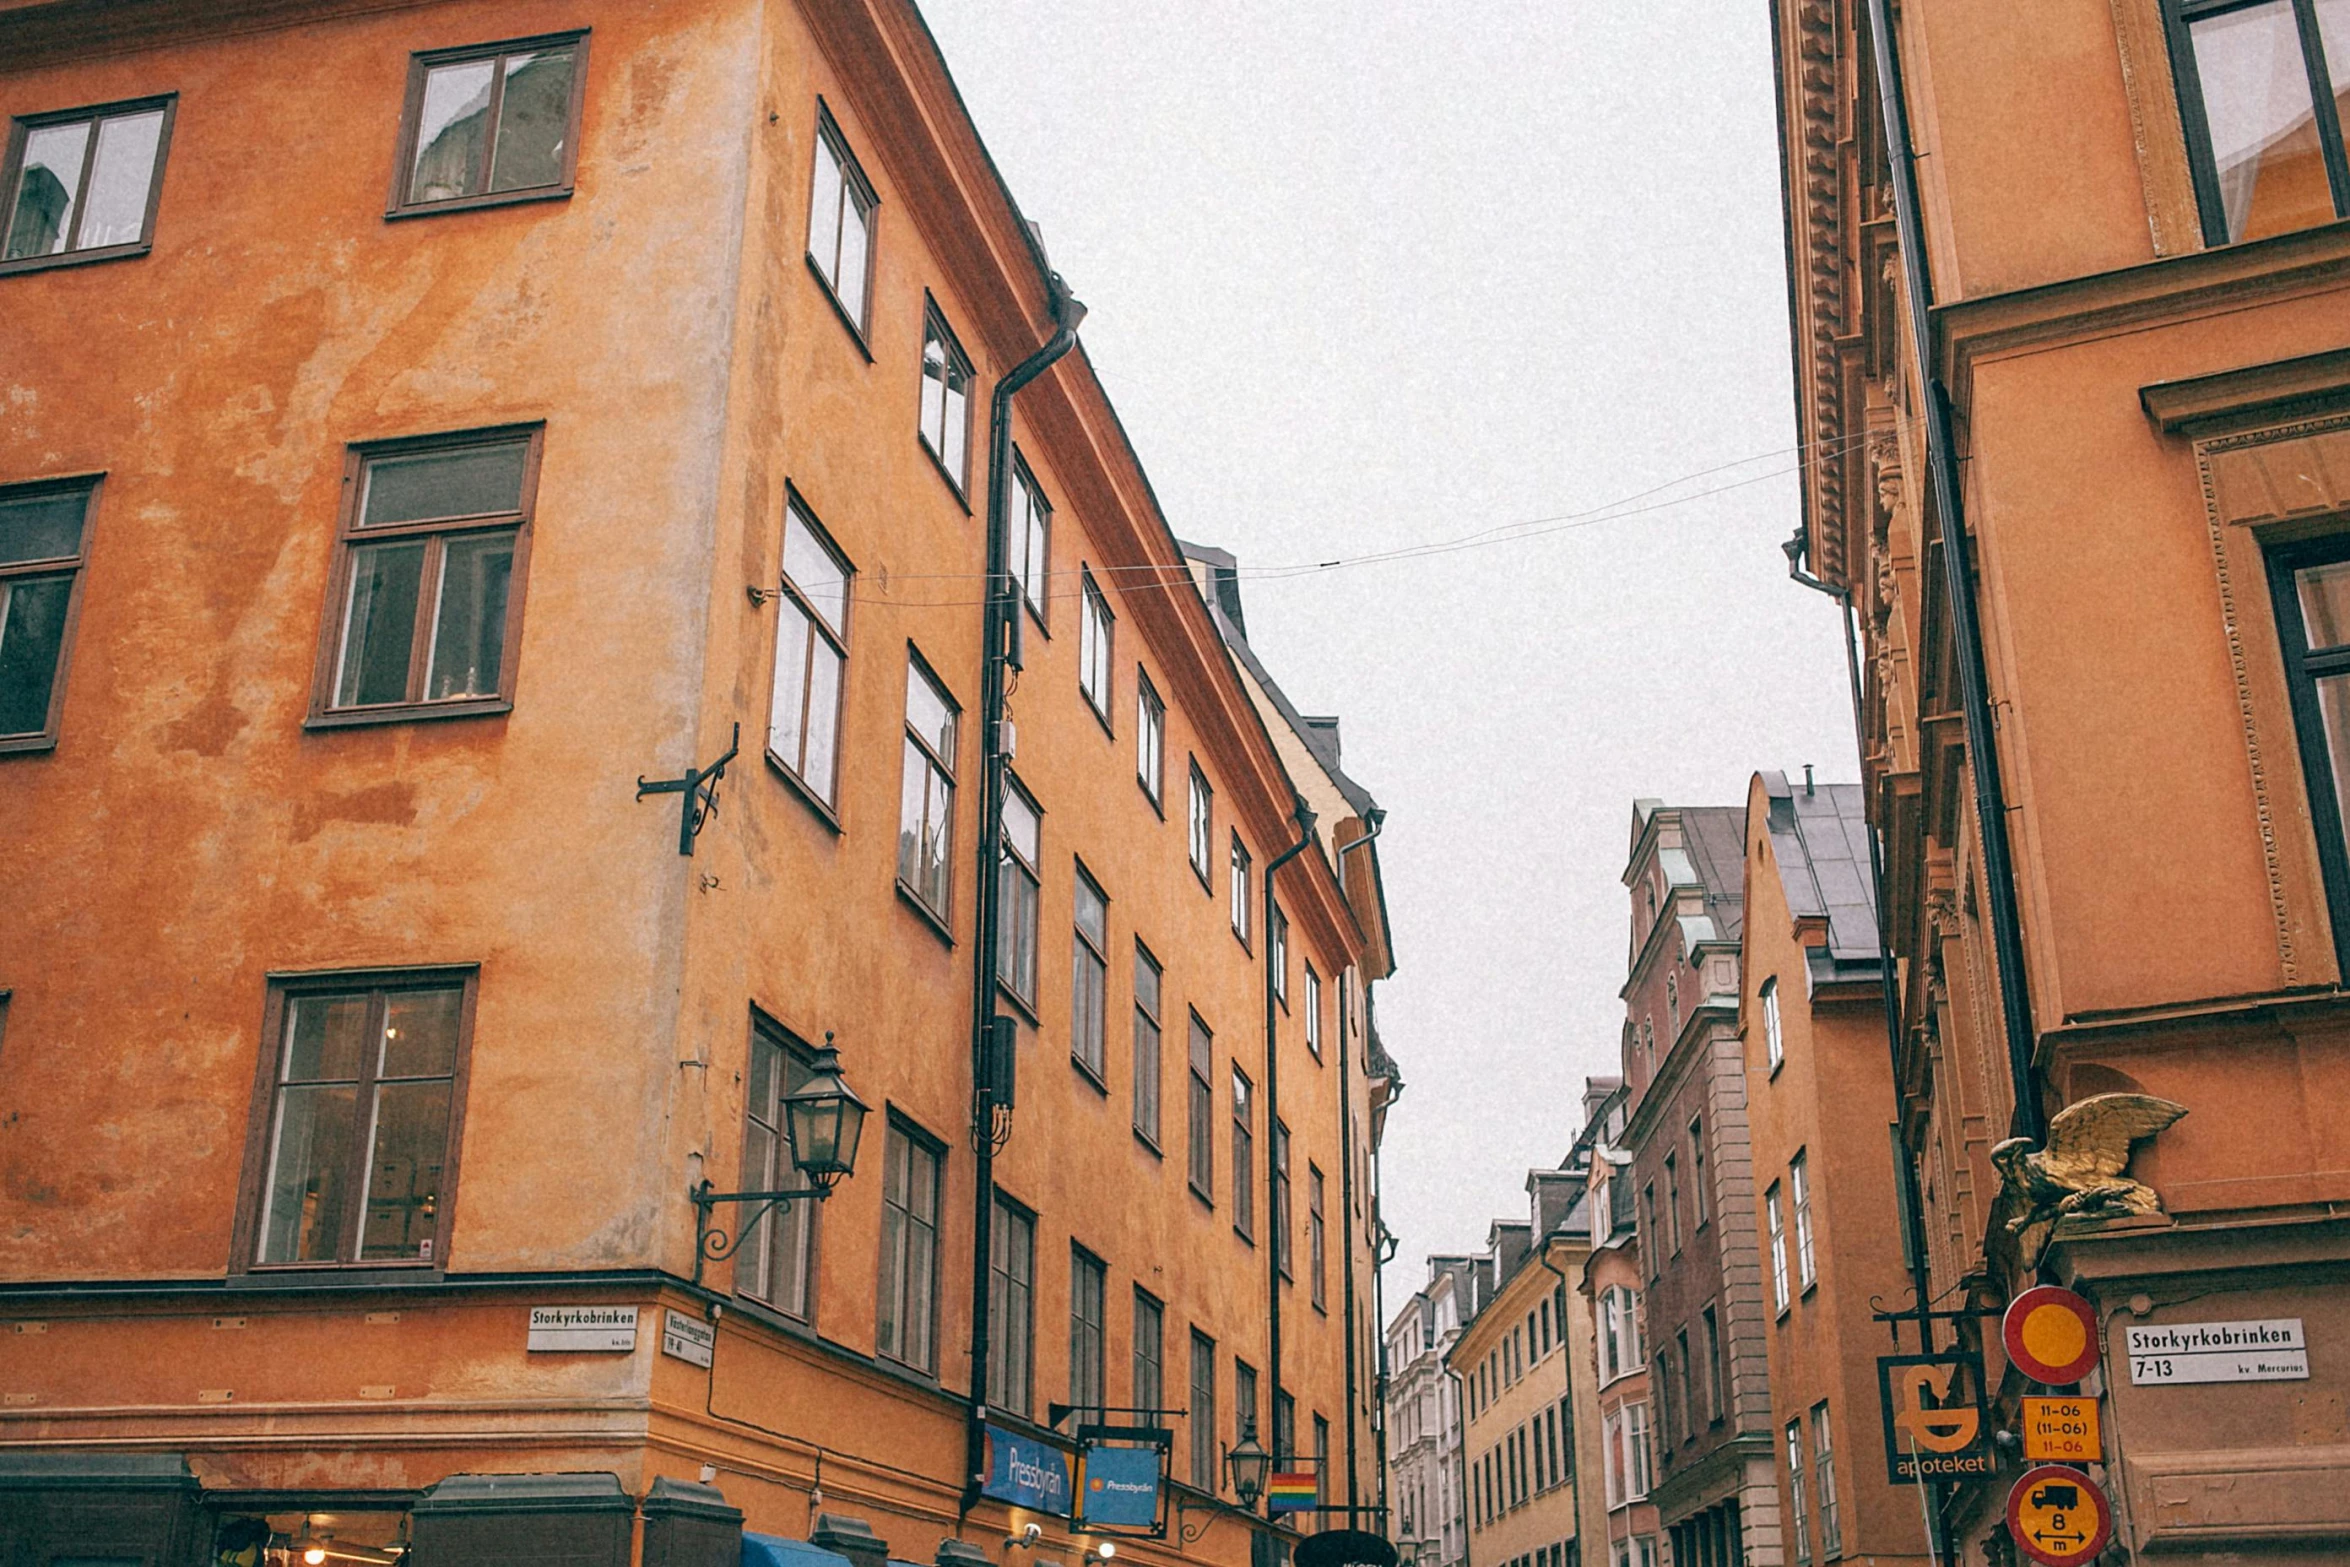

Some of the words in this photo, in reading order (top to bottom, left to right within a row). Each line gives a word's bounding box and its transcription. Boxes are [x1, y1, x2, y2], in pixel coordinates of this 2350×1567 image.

[533, 1310, 633, 1327] Storkyrkobrinken
[2132, 1326, 2291, 1351] Storkyrkobrinken
[2137, 1360, 2173, 1378] 7-13
[2258, 1364, 2303, 1373] Mercurius
[2041, 1405, 2080, 1417] 11-06
[2037, 1423, 2087, 1436] (11-06)
[2043, 1441, 2083, 1453] 11-06
[1009, 1447, 1060, 1498] Pressbyrån
[1897, 1456, 1986, 1478] apoteket
[1107, 1480, 1153, 1494] Pressbyrån
[2052, 1514, 2066, 1530] 8
[2053, 1541, 2067, 1551] m
